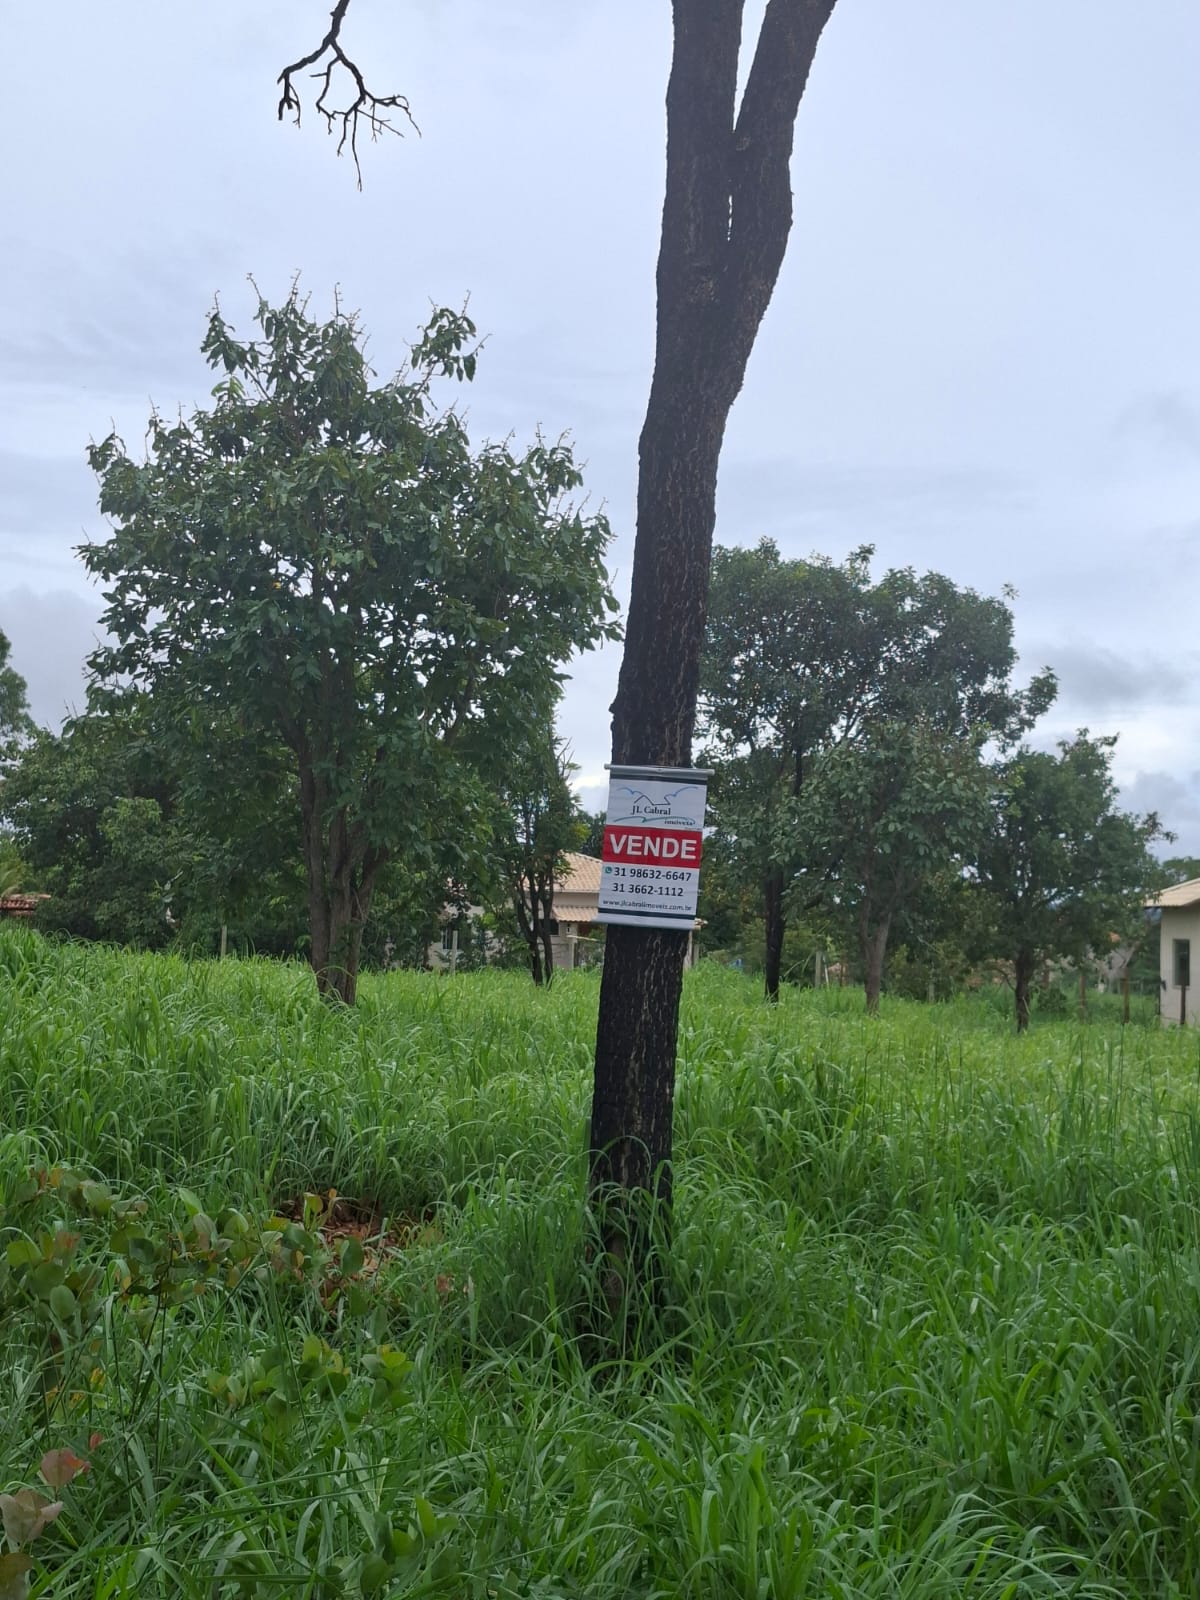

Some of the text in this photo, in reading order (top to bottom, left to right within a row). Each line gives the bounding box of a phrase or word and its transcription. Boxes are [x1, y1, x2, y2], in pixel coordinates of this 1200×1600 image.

[631, 805, 671, 816] JL Cabral
[610, 834, 697, 859] VENDE
[614, 867, 692, 882] 31 98632-6647
[612, 883, 684, 897] 31 3662-1112
